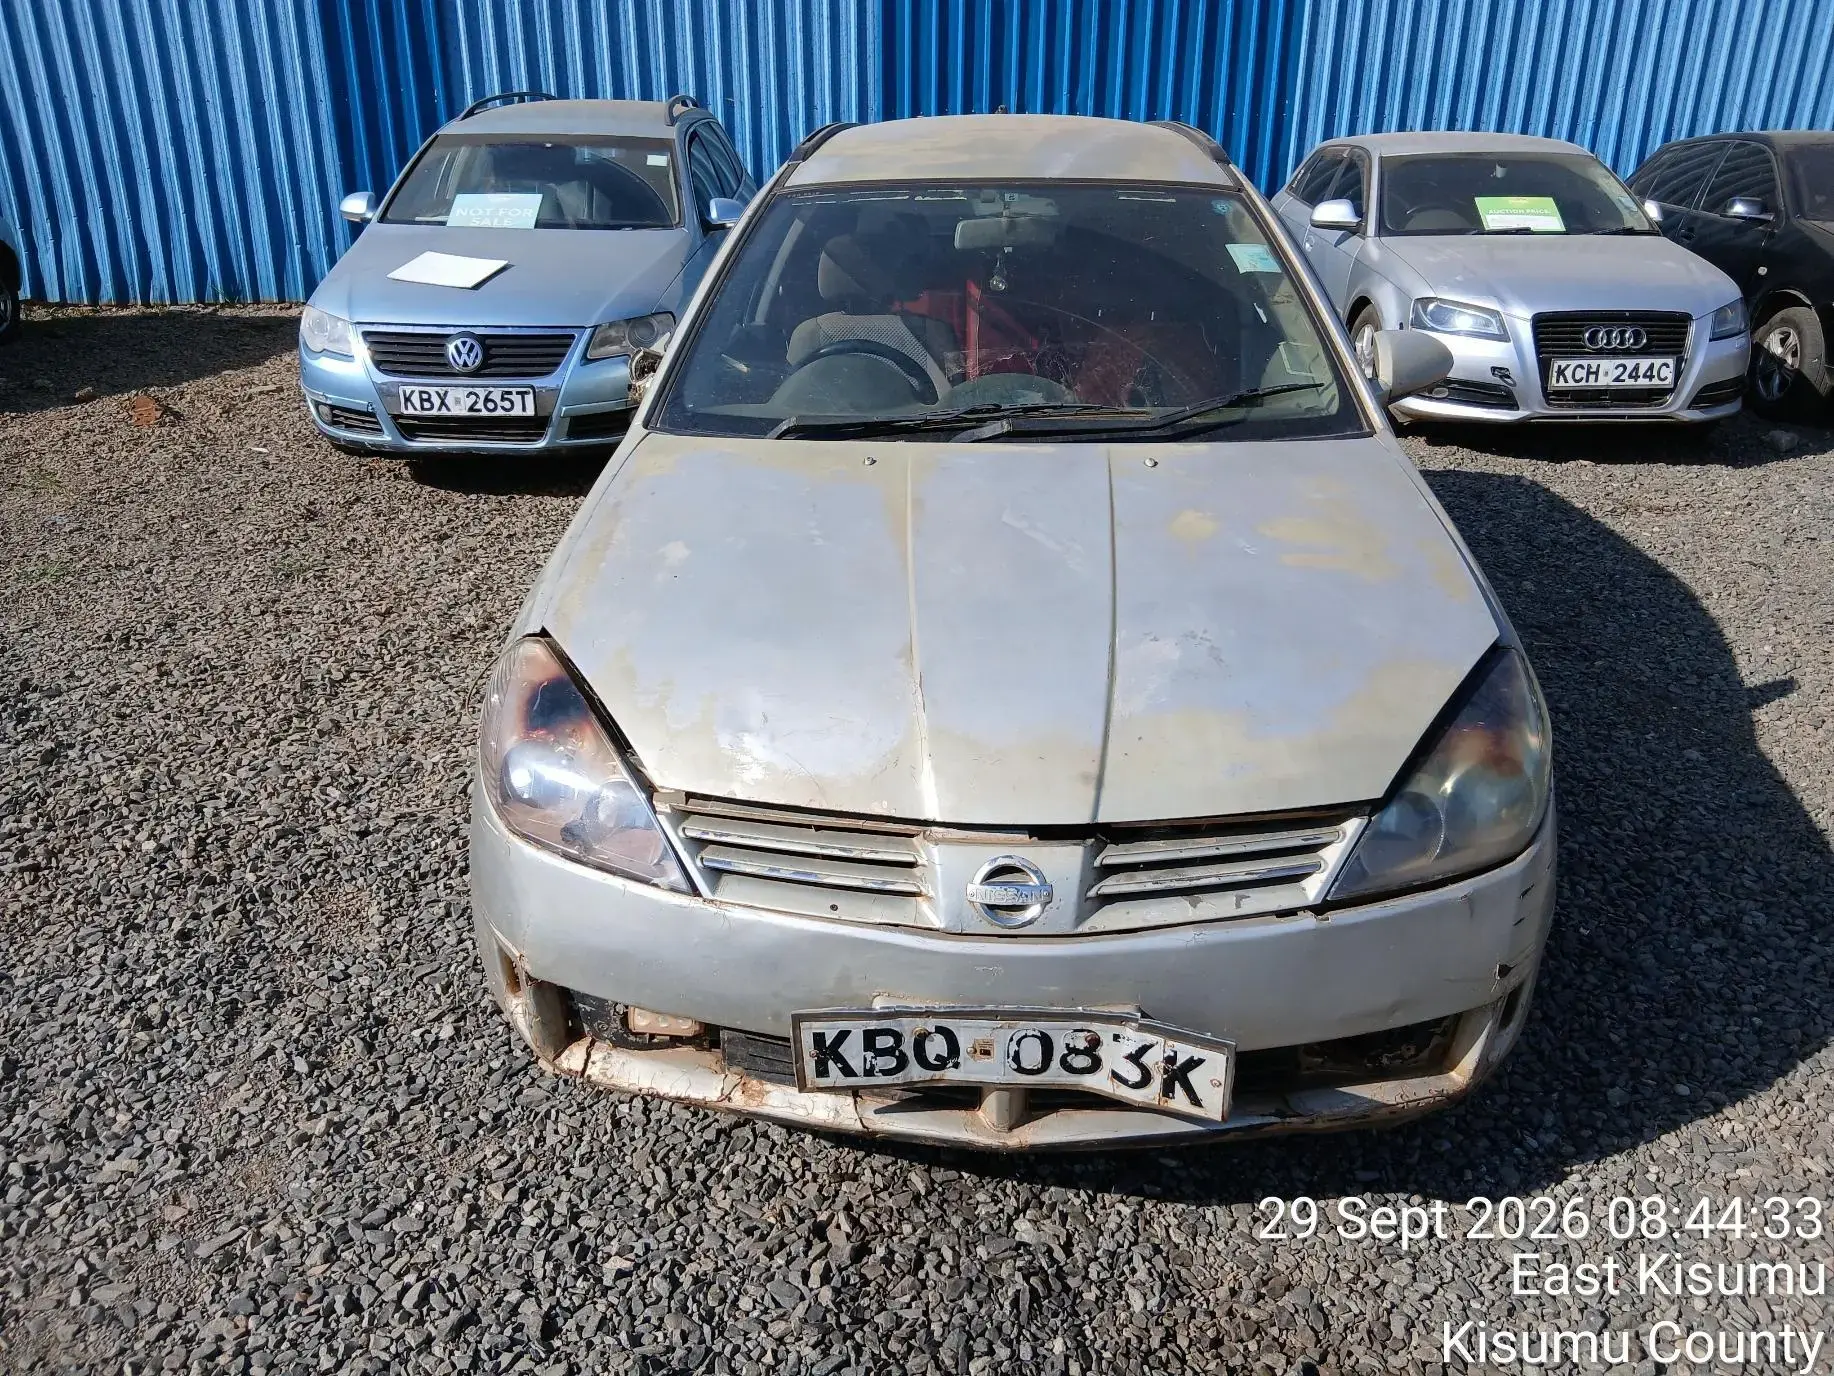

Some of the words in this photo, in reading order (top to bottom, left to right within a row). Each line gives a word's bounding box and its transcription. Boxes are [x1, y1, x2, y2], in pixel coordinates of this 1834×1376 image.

[455, 207, 494, 217] NOT
[498, 208, 533, 217] FOR
[469, 217, 514, 226] SALE
[1555, 363, 1600, 384] KCH
[1611, 362, 1671, 383] 244C
[402, 389, 452, 412] KBX
[465, 390, 531, 413] 265T
[976, 888, 1043, 903] NISSAN
[811, 1025, 961, 1079] KBQ
[1005, 1028, 1207, 1109] 083K
